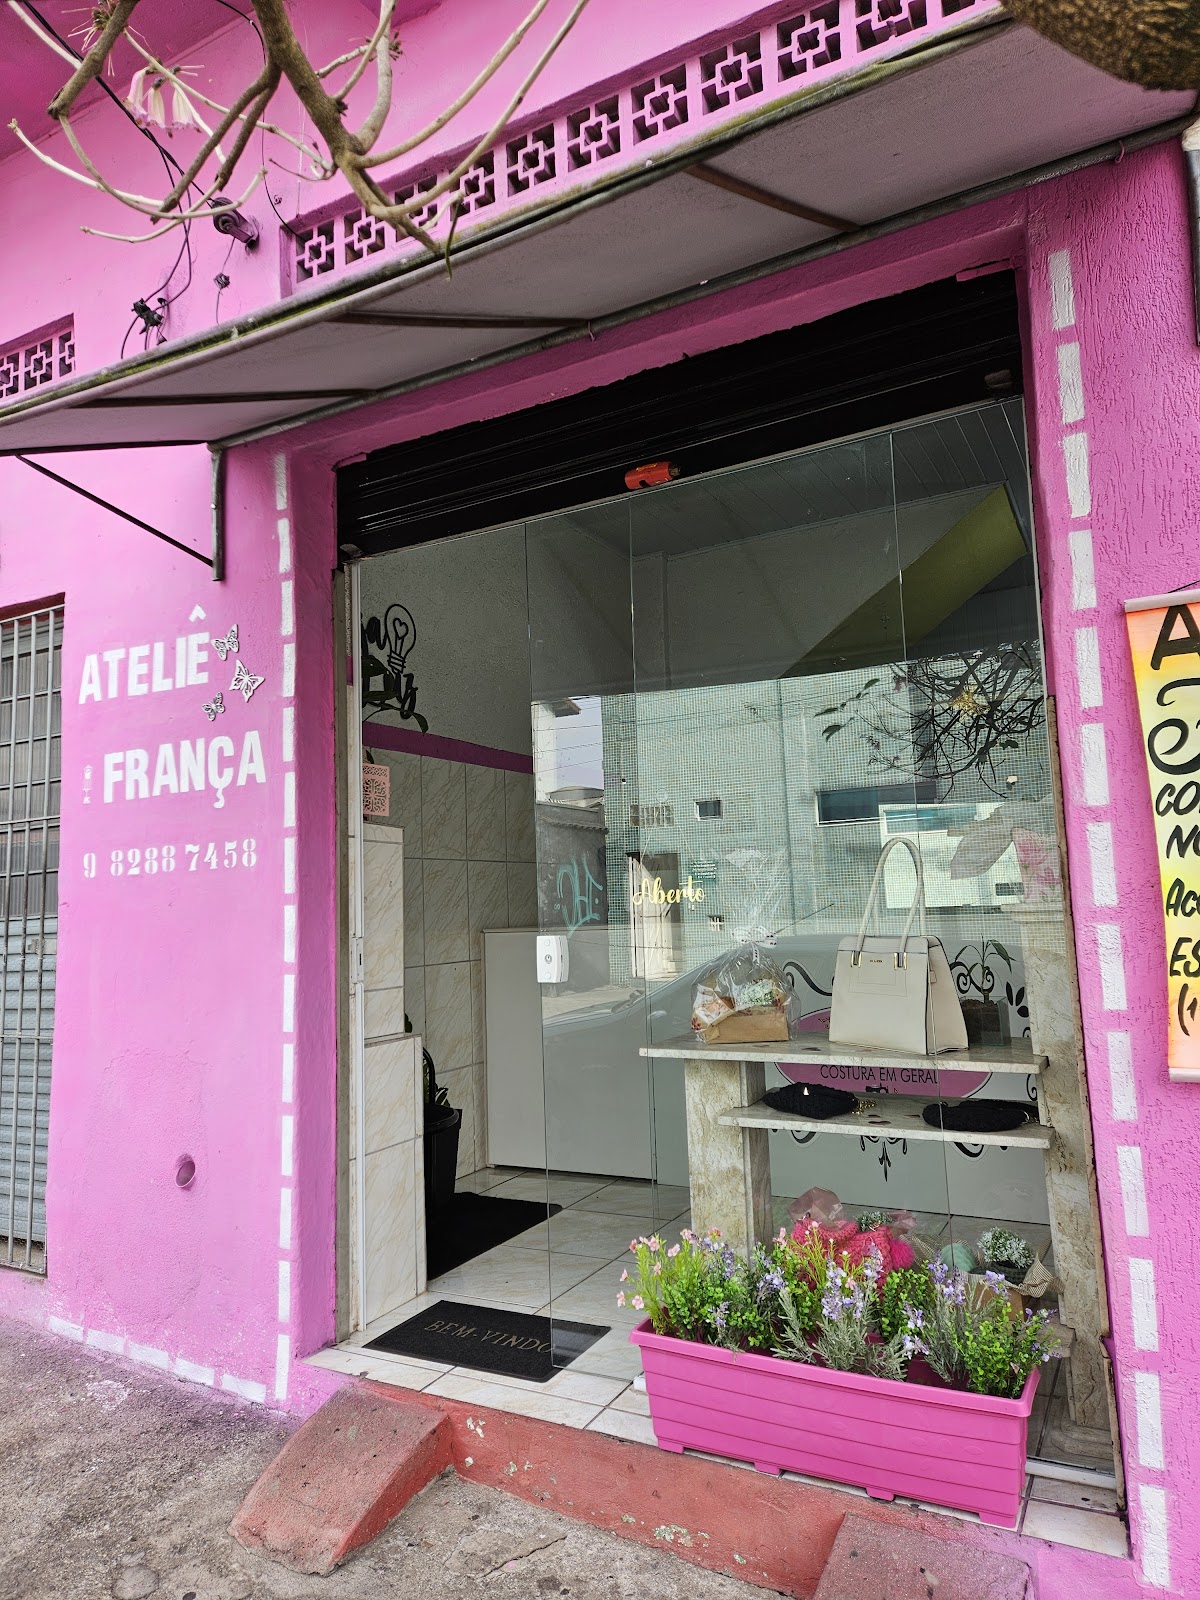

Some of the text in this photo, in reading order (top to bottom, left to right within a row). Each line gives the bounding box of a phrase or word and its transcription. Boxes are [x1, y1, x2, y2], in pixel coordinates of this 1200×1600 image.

[79, 604, 210, 704] ATELIÊ
[103, 730, 266, 808] FRANÇA
[1155, 781, 1200, 817] CO
[83, 838, 258, 878] 9 8288 7458
[632, 876, 706, 906] Aberto
[820, 1065, 938, 1084] COSTURA EM GERAL
